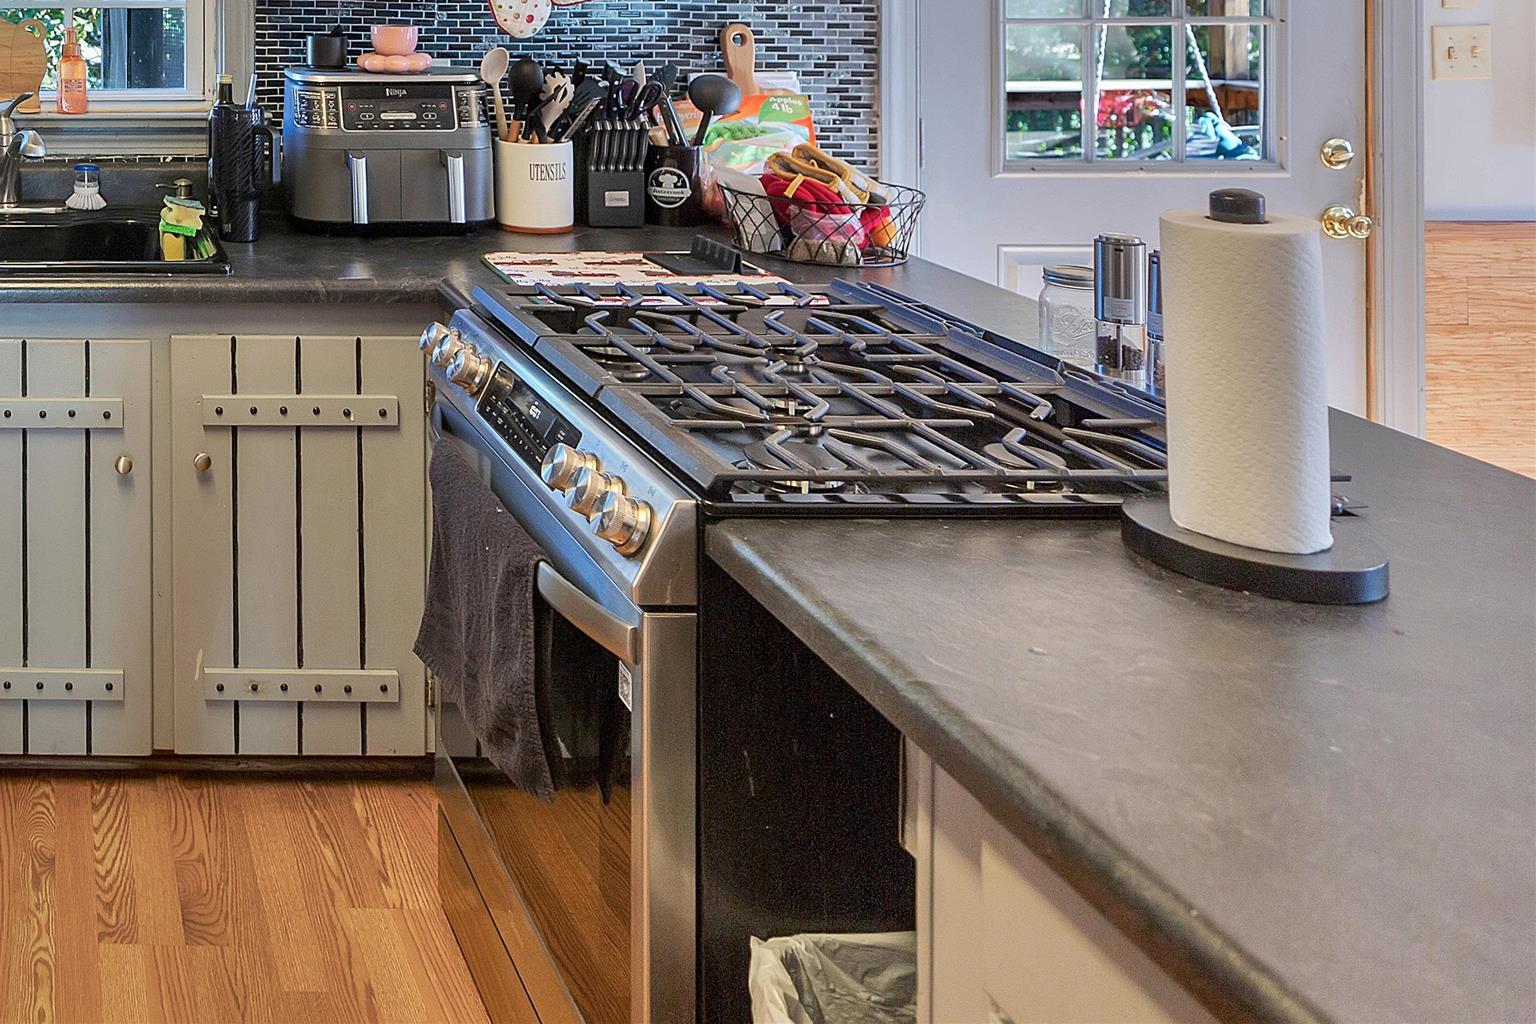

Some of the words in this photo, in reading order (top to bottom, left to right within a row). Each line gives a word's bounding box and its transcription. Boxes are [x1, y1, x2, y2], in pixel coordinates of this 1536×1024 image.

[769, 96, 802, 106] Apples
[771, 103, 780, 111] 4
[781, 103, 794, 114] lb
[529, 162, 567, 181] UTENSILS
